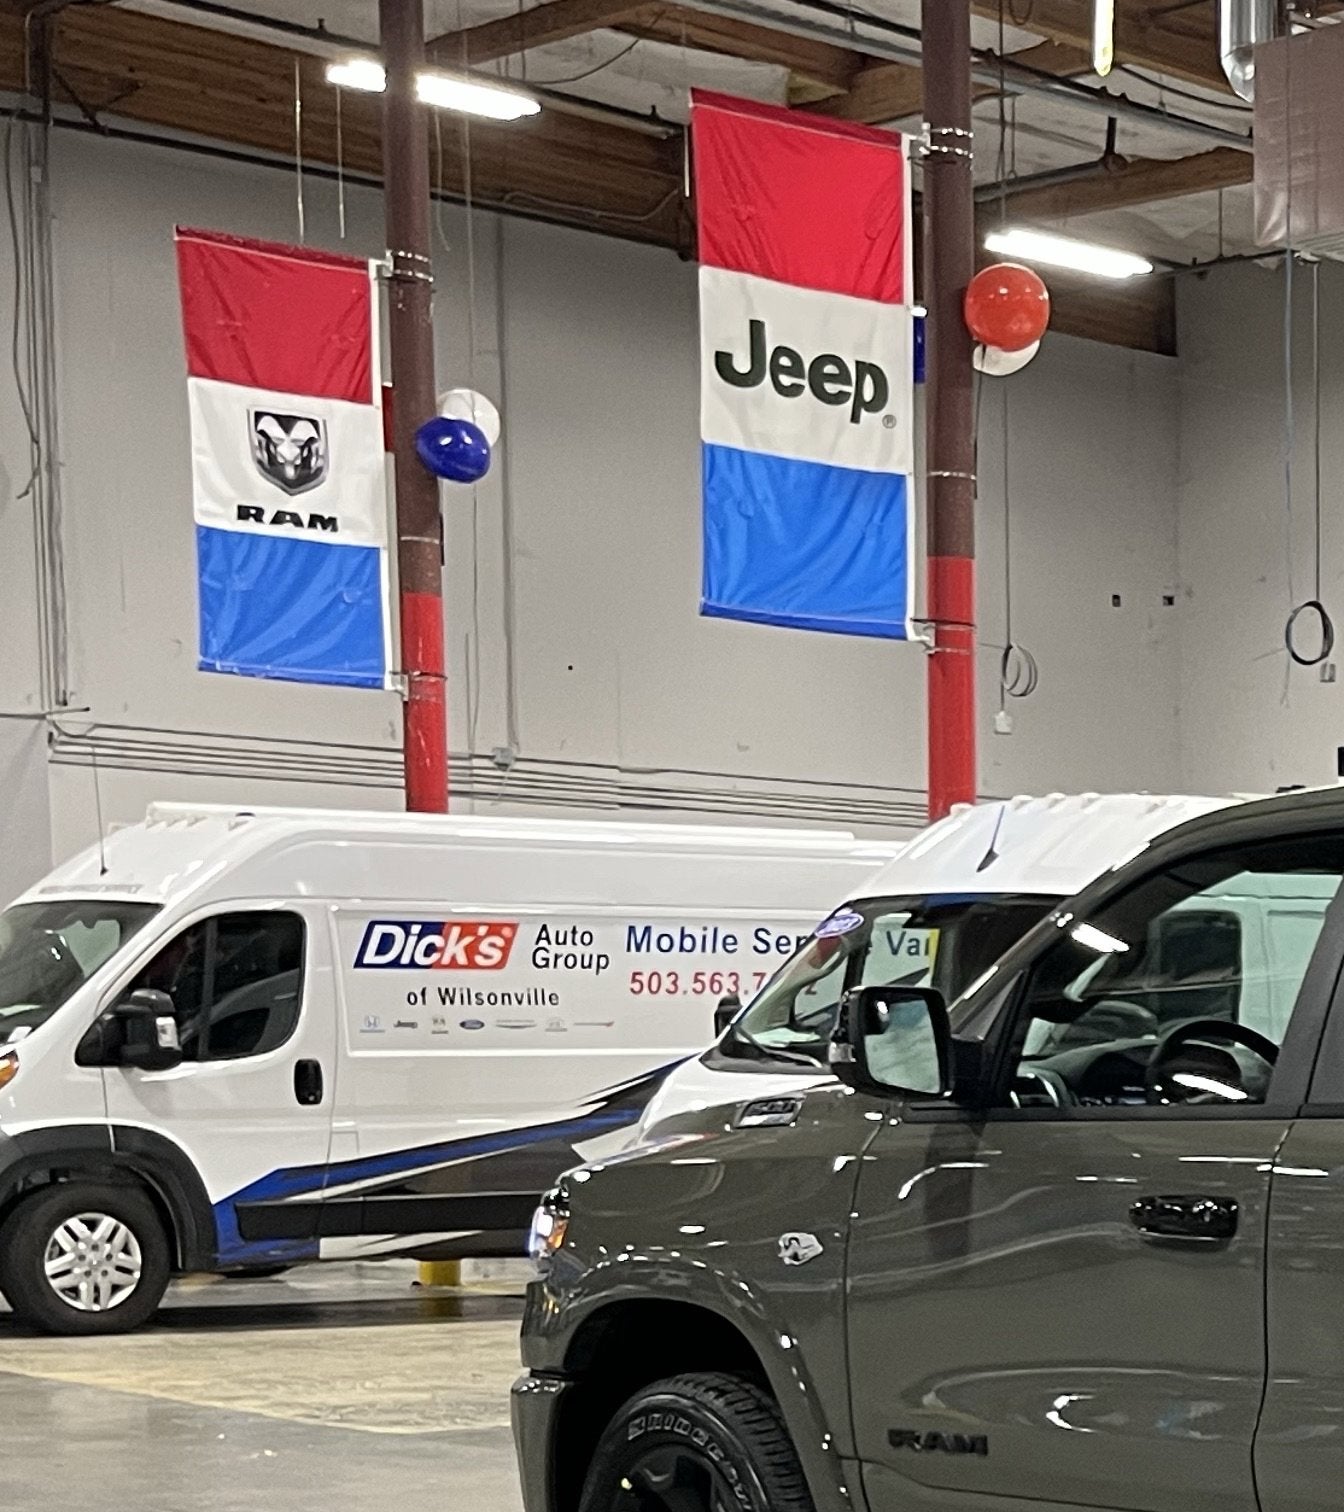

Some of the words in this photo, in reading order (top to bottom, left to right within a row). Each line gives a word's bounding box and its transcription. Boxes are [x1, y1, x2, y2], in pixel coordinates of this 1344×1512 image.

[715, 319, 889, 424] Jeep
[237, 504, 338, 533] RAM
[535, 923, 595, 946] Auto
[626, 925, 739, 954] Mobile
[532, 946, 610, 976] Group
[407, 987, 427, 1006] of
[438, 987, 560, 1006] Wilsonville
[887, 1429, 988, 1456] RAM
